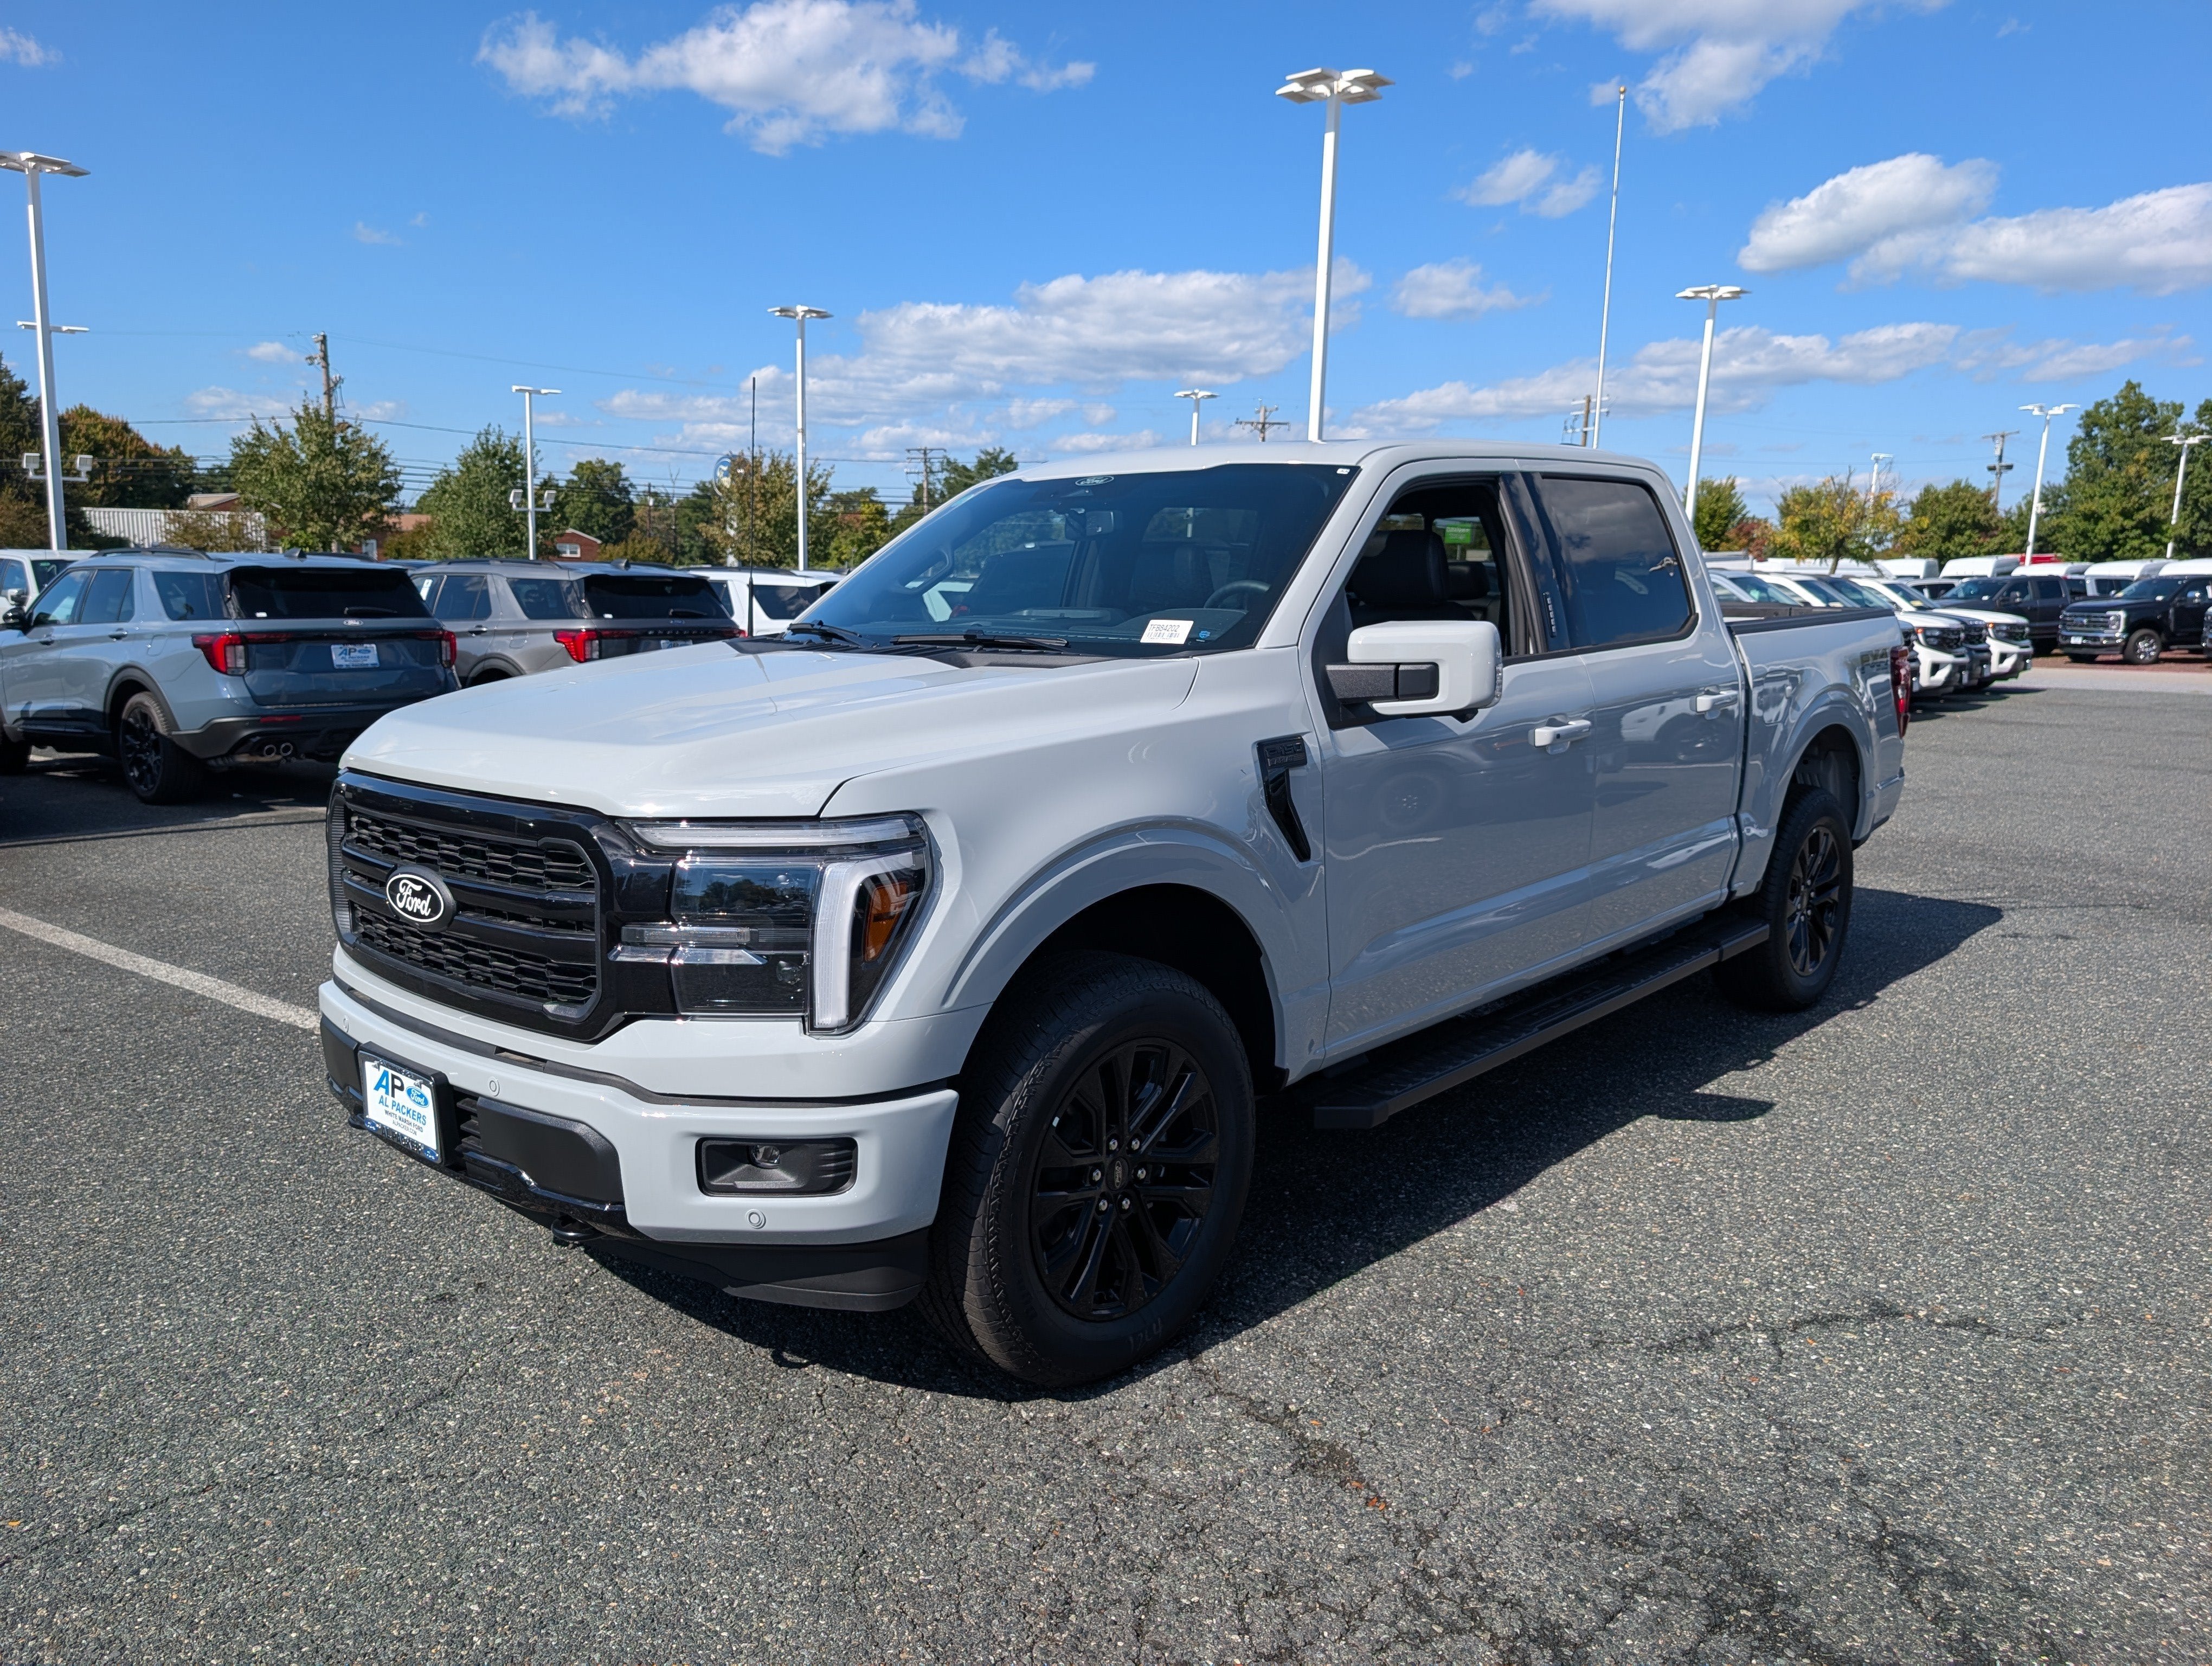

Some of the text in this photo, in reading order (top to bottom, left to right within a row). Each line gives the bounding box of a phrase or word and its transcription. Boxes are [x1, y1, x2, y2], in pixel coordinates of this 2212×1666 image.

[338, 647, 357, 656] AP
[396, 879, 432, 917] Ford
[373, 1069, 405, 1099] AP
[410, 1088, 426, 1105] Ford
[378, 1094, 389, 1108] AL
[391, 1100, 427, 1126] PACKERS
[384, 1109, 423, 1133] WHITE MARSH FORD
